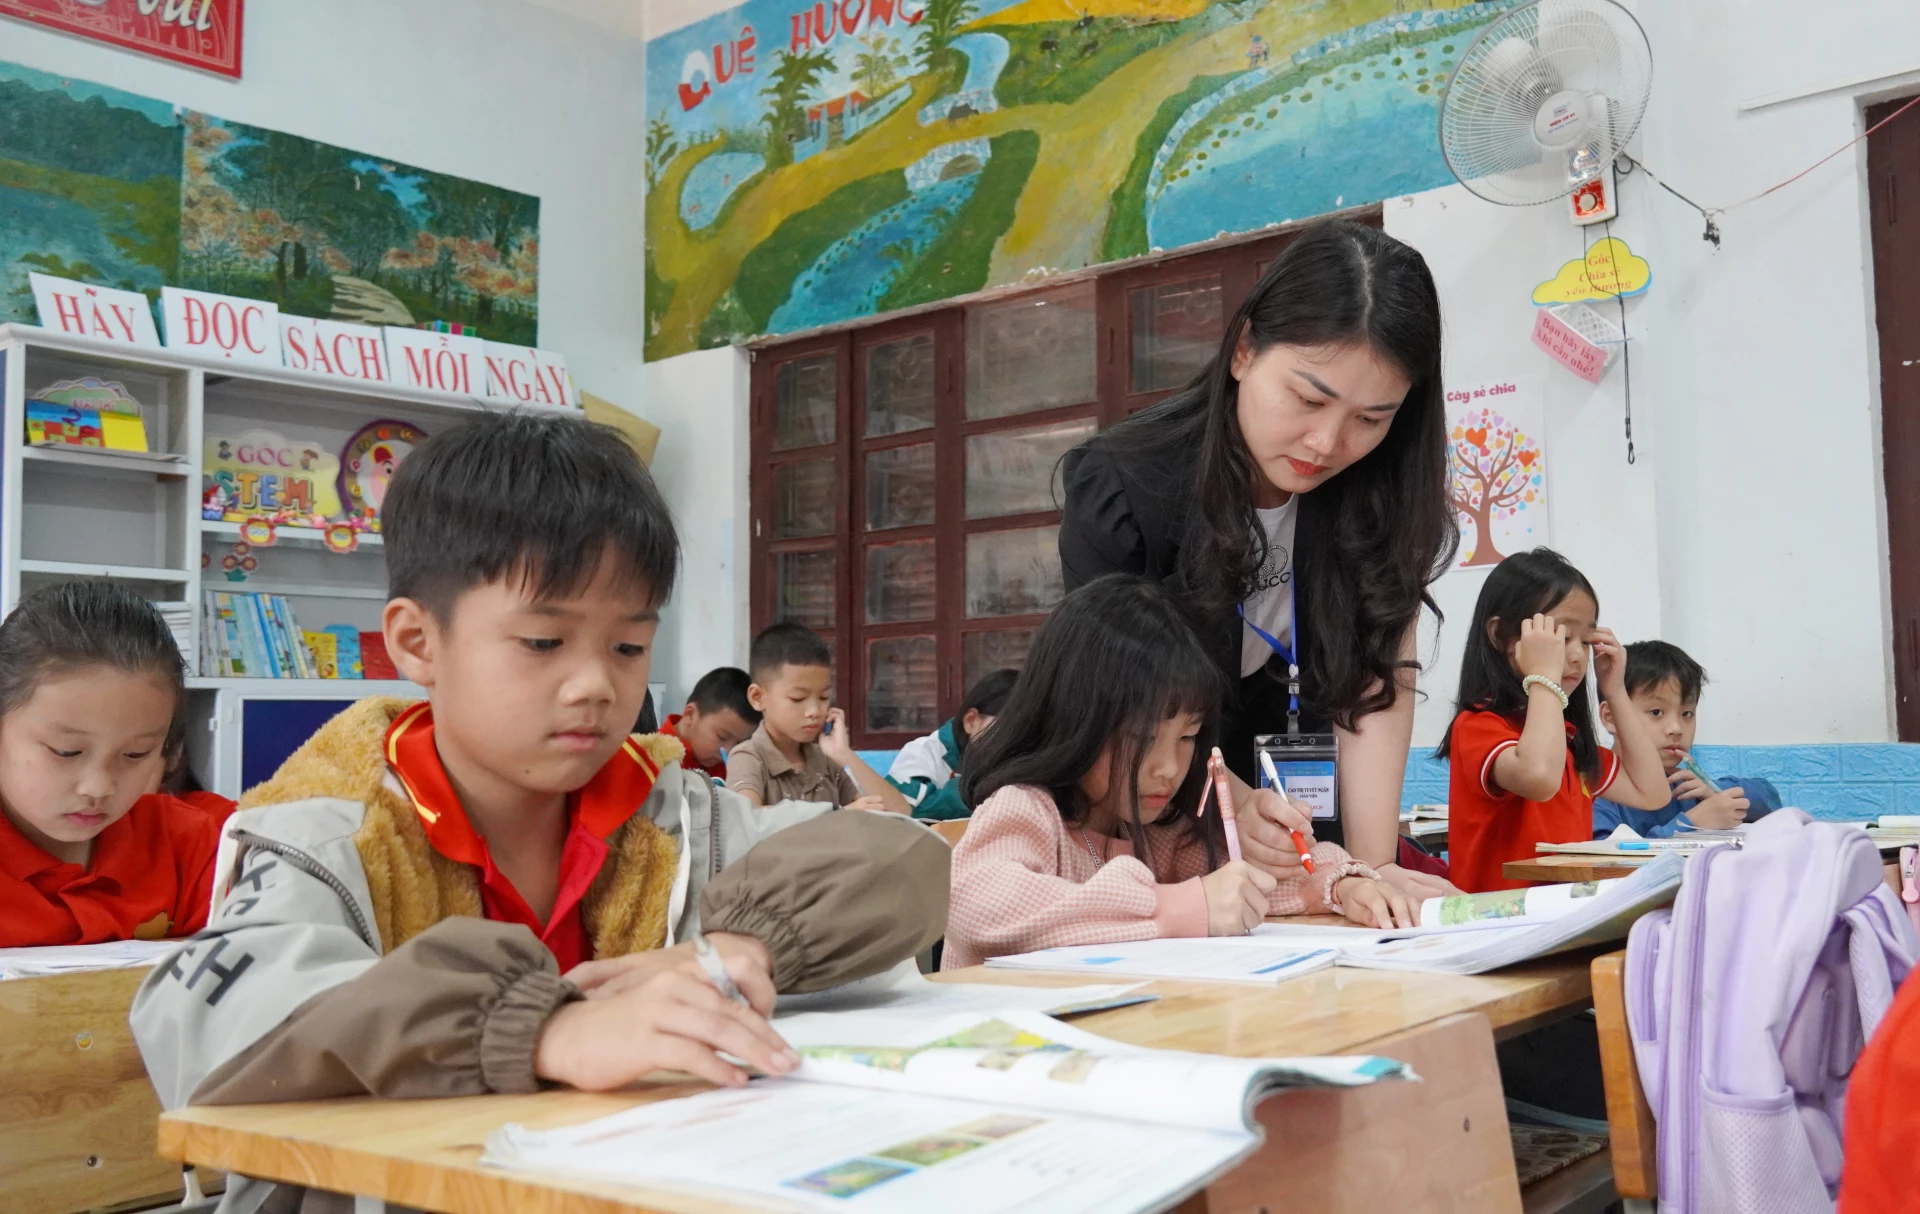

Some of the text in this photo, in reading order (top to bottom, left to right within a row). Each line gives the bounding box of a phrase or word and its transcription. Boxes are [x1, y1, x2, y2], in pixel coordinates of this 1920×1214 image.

[677, 26, 756, 112] QUÊ
[1588, 253, 1611, 267] Góc
[52, 288, 569, 406] HÃY ĐỌC SÁCH MỖI NGÀY
[1536, 329, 1552, 346] khi
[1552, 344, 1569, 360] cần
[1542, 318, 1597, 363] Bạn hãy lấy
[1489, 383, 1516, 396] chia
[237, 443, 293, 468] GÓC
[215, 470, 313, 511] STEM
